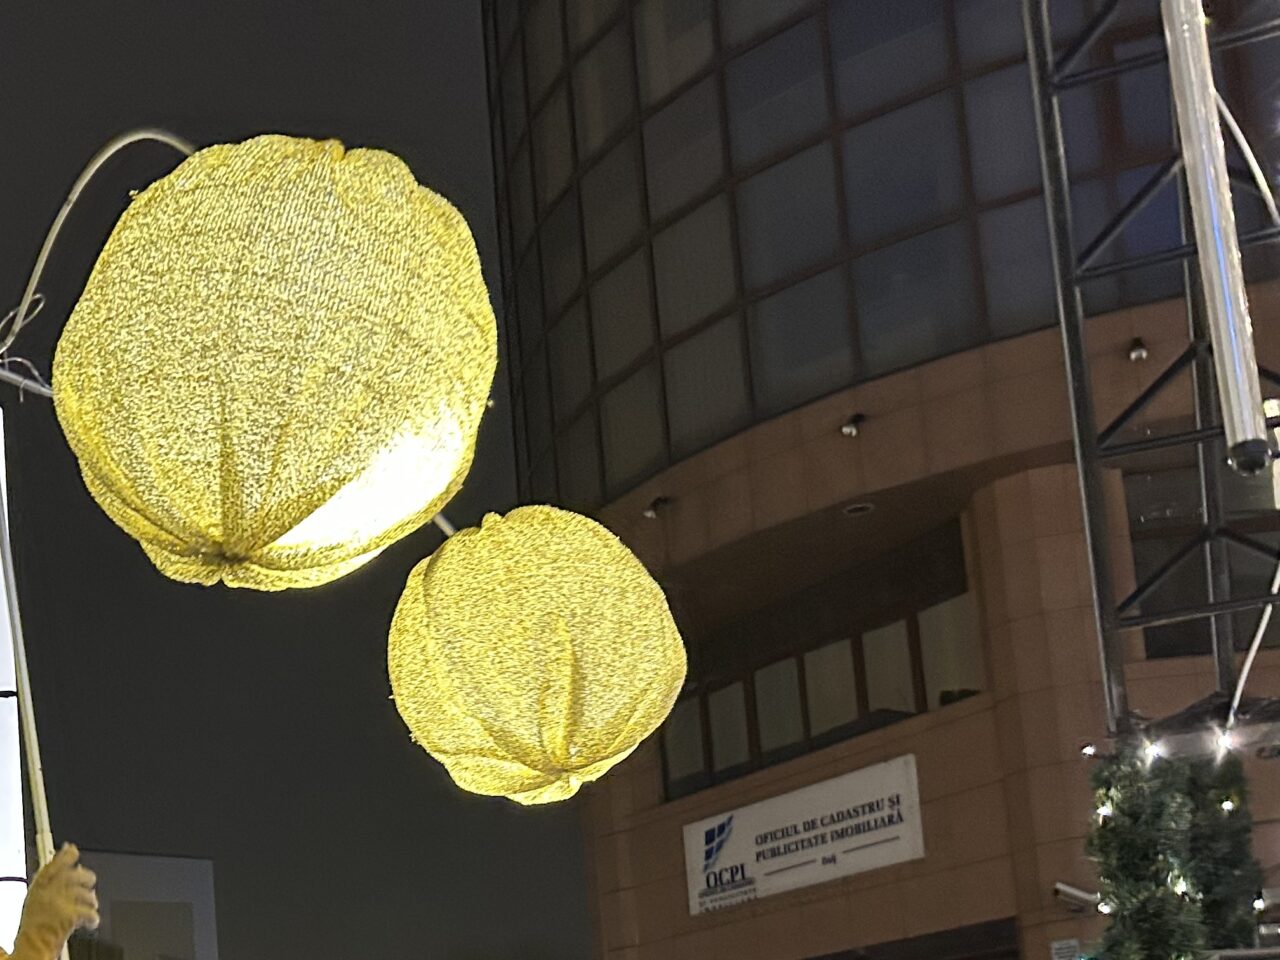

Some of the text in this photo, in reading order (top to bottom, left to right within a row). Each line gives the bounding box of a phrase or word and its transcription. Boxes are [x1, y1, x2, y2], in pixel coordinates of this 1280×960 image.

[755, 824, 800, 846] OFICIUL
[803, 818, 818, 833] DE
[820, 798, 885, 827] CADASTRU
[755, 832, 829, 862] PUBLICITATE
[706, 863, 746, 888] OCPI
